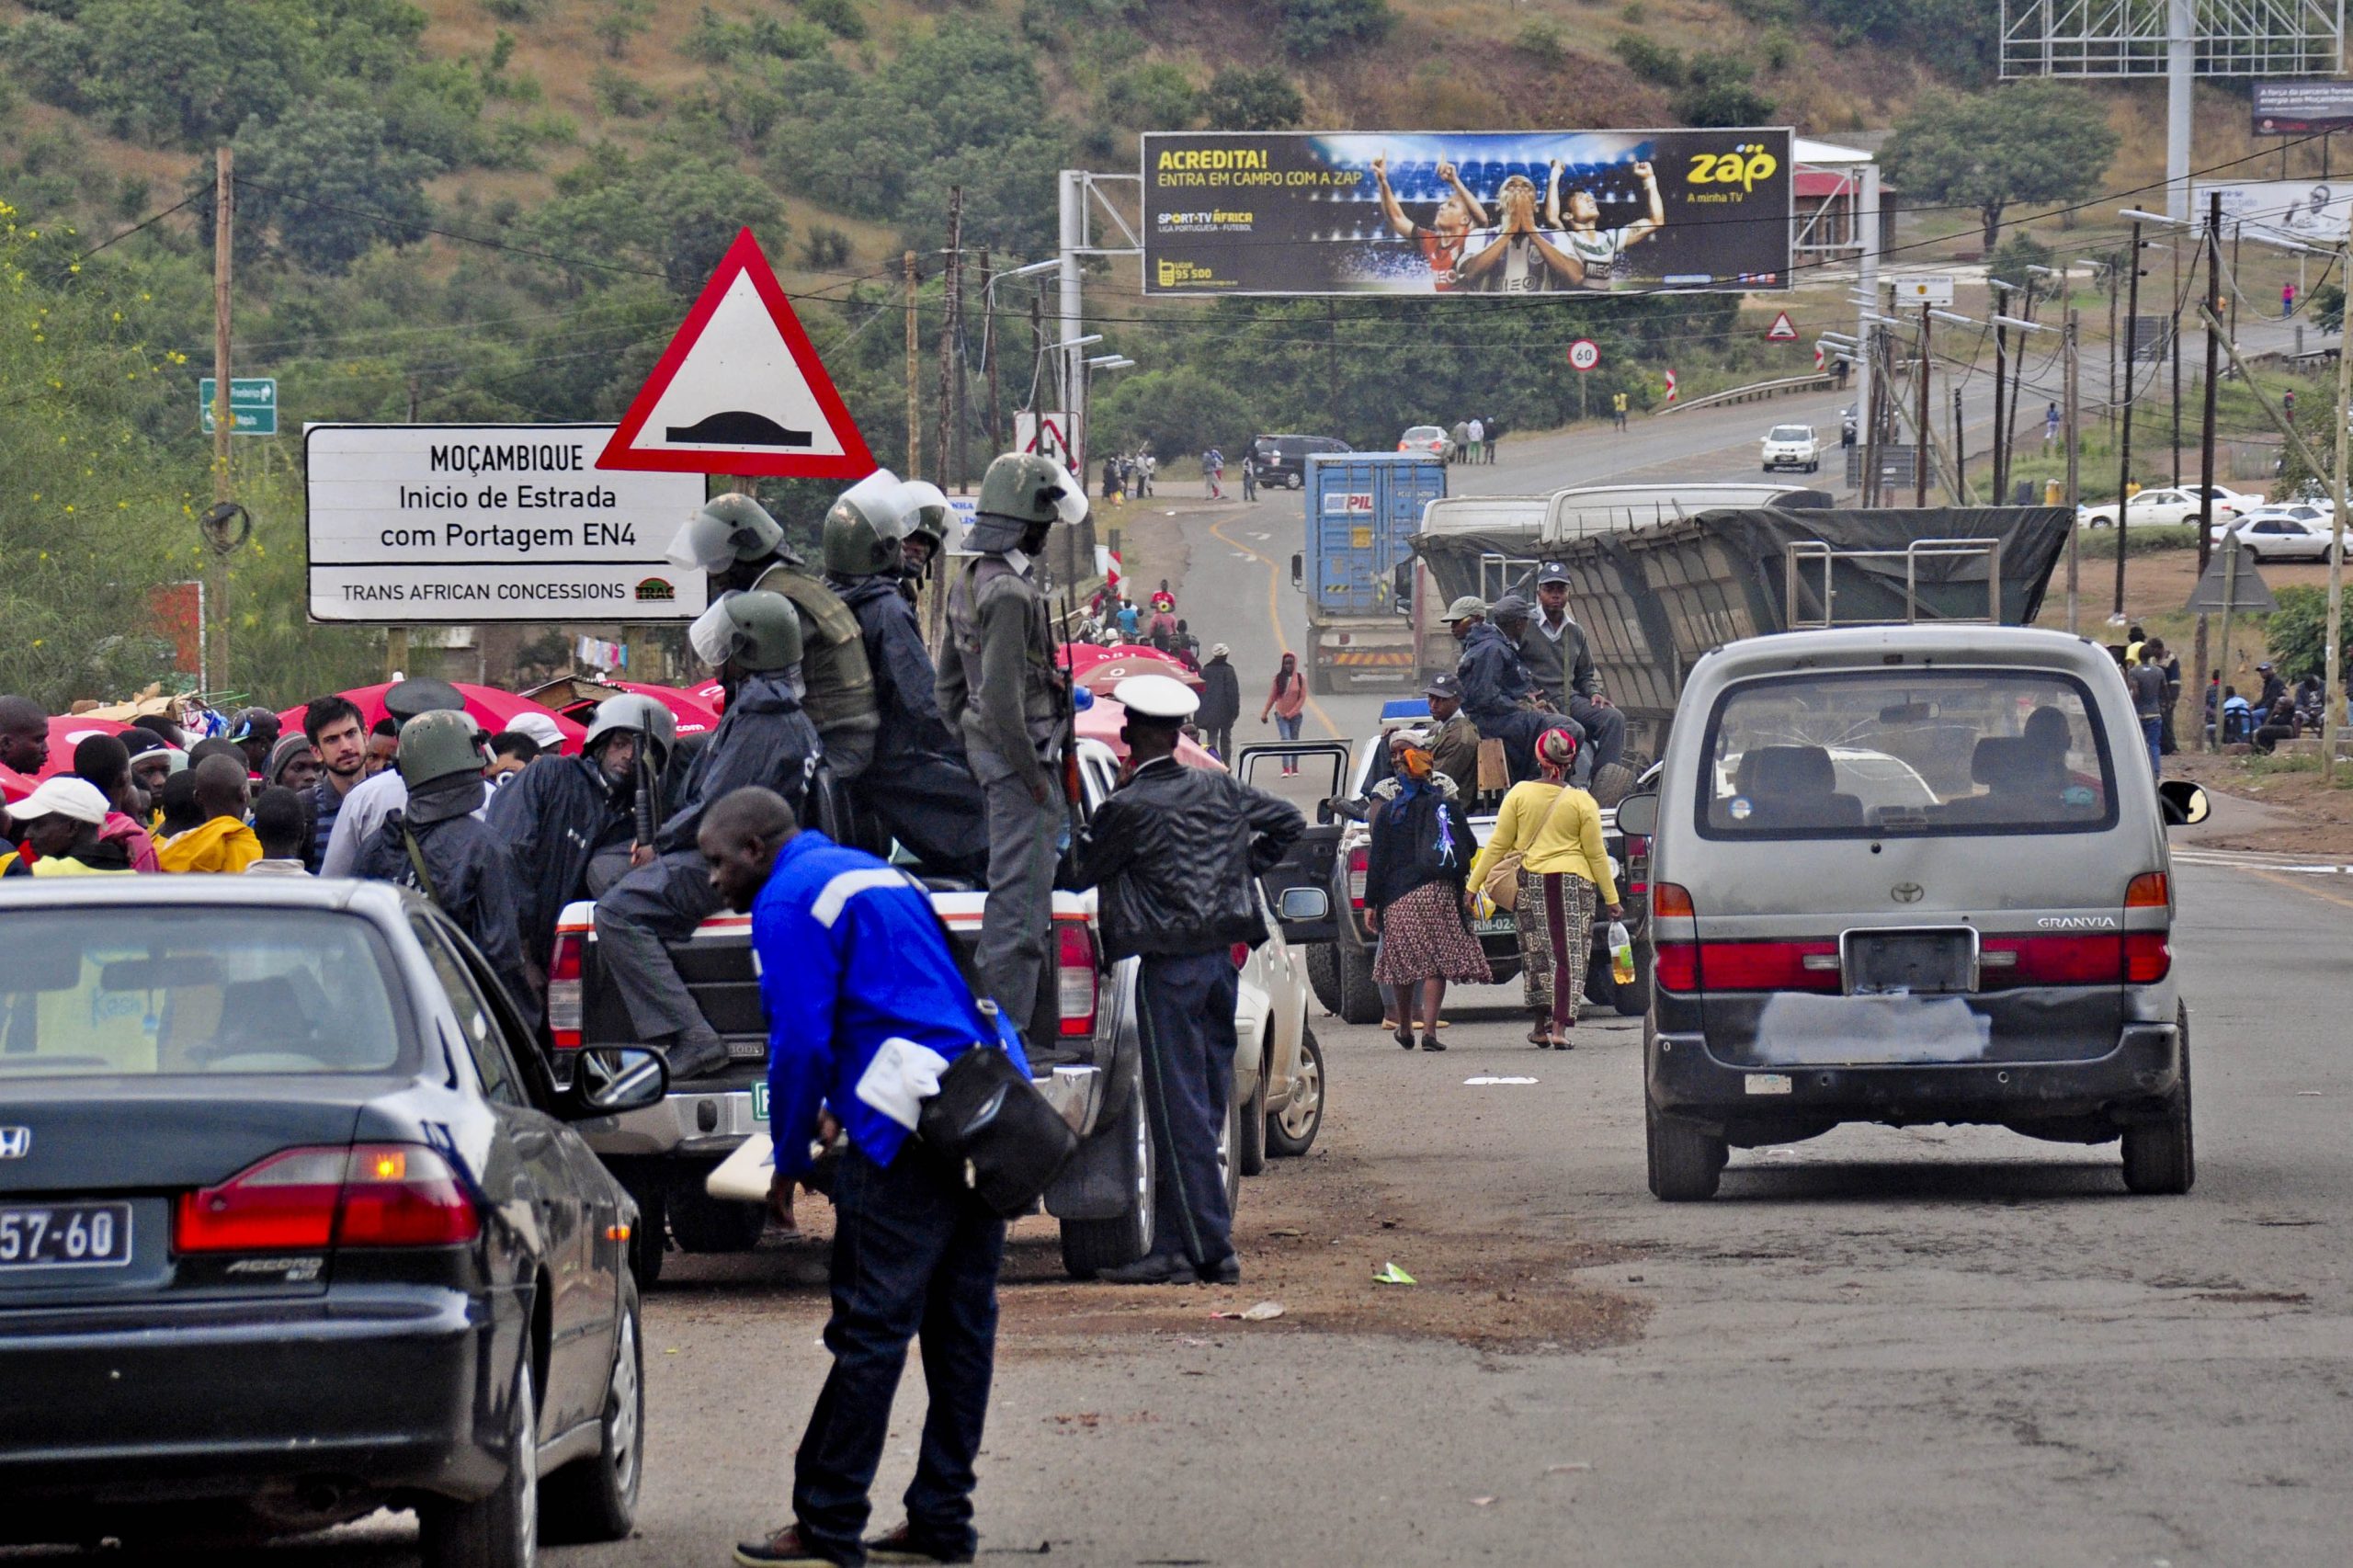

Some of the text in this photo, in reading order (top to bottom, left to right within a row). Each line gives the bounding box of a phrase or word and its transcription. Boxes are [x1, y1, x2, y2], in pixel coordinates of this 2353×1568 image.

[1158, 150, 1267, 169] ACREDITA!
[1158, 171, 1362, 187] ENTRA EM CAMPO COM A ZAP
[1688, 193, 1744, 202] A minha TV
[1576, 349, 1592, 360] 60
[431, 445, 584, 477] MOÇAMBIQUE
[400, 485, 616, 508] Inicio de Estrada
[1347, 496, 1372, 510] PIL
[381, 522, 636, 551] com Portagem EN4
[342, 585, 404, 600] TRANS
[410, 585, 490, 599] AFRICAN
[497, 584, 625, 599] CONCESSIONS
[2037, 917, 2115, 927] GRANVIA
[0, 1212, 113, 1259] 57-60
